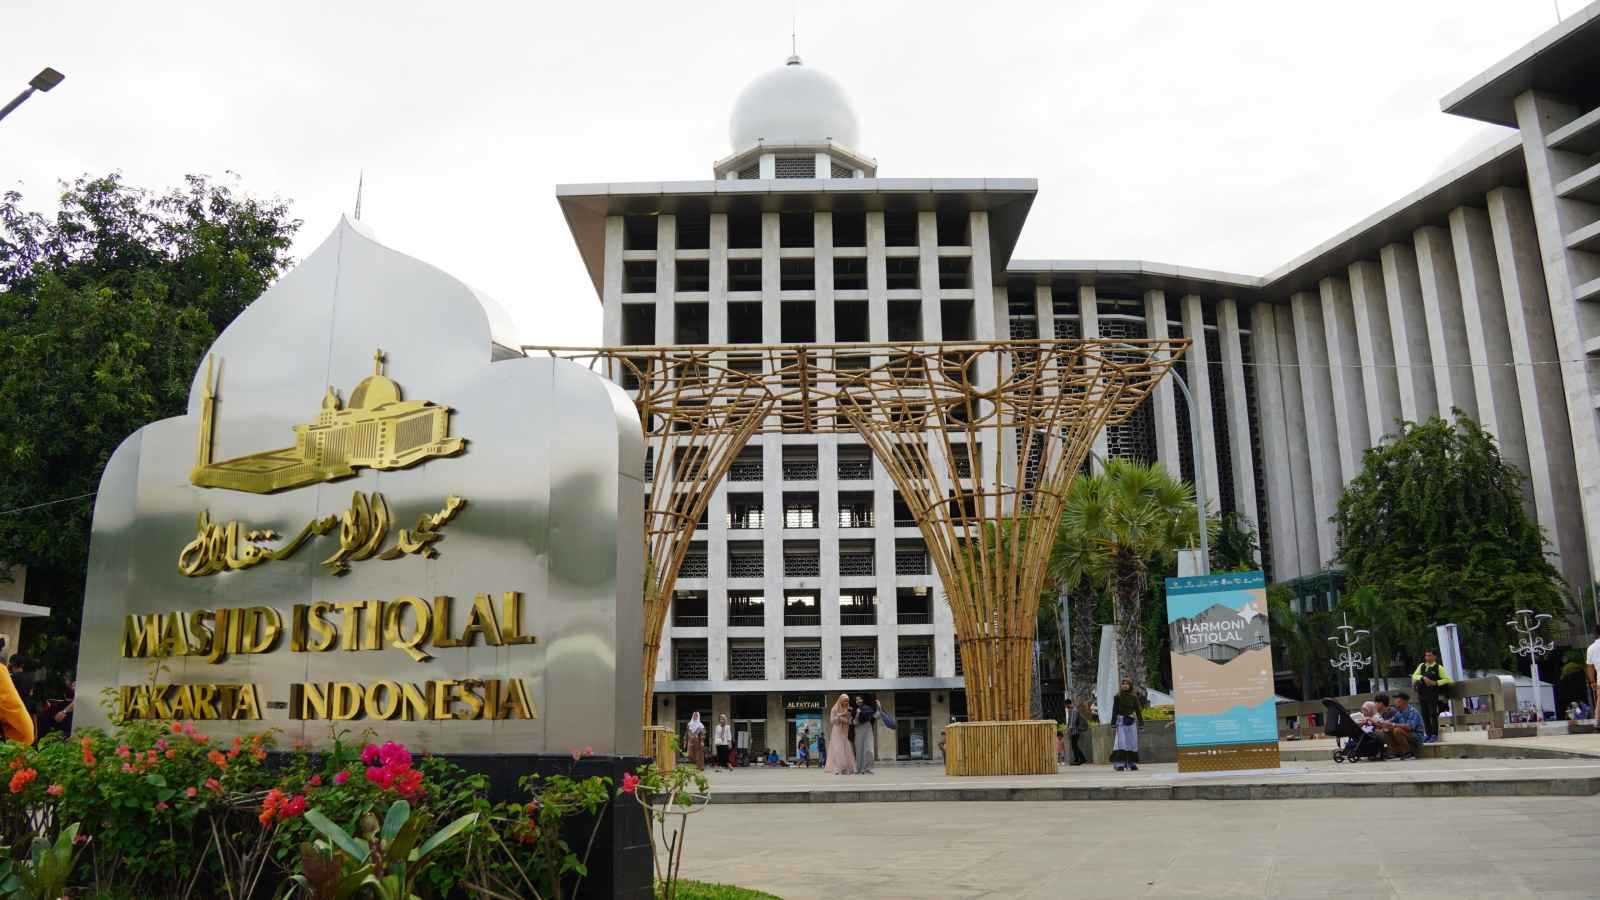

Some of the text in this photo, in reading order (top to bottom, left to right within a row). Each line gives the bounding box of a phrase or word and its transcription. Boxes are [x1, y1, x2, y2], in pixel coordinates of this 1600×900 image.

[121, 591, 536, 664] MASJID ISTIQLAL
[1181, 619, 1245, 634] HARMONI
[117, 683, 263, 724] JAKARTA
[288, 678, 537, 721] INDONESIA
